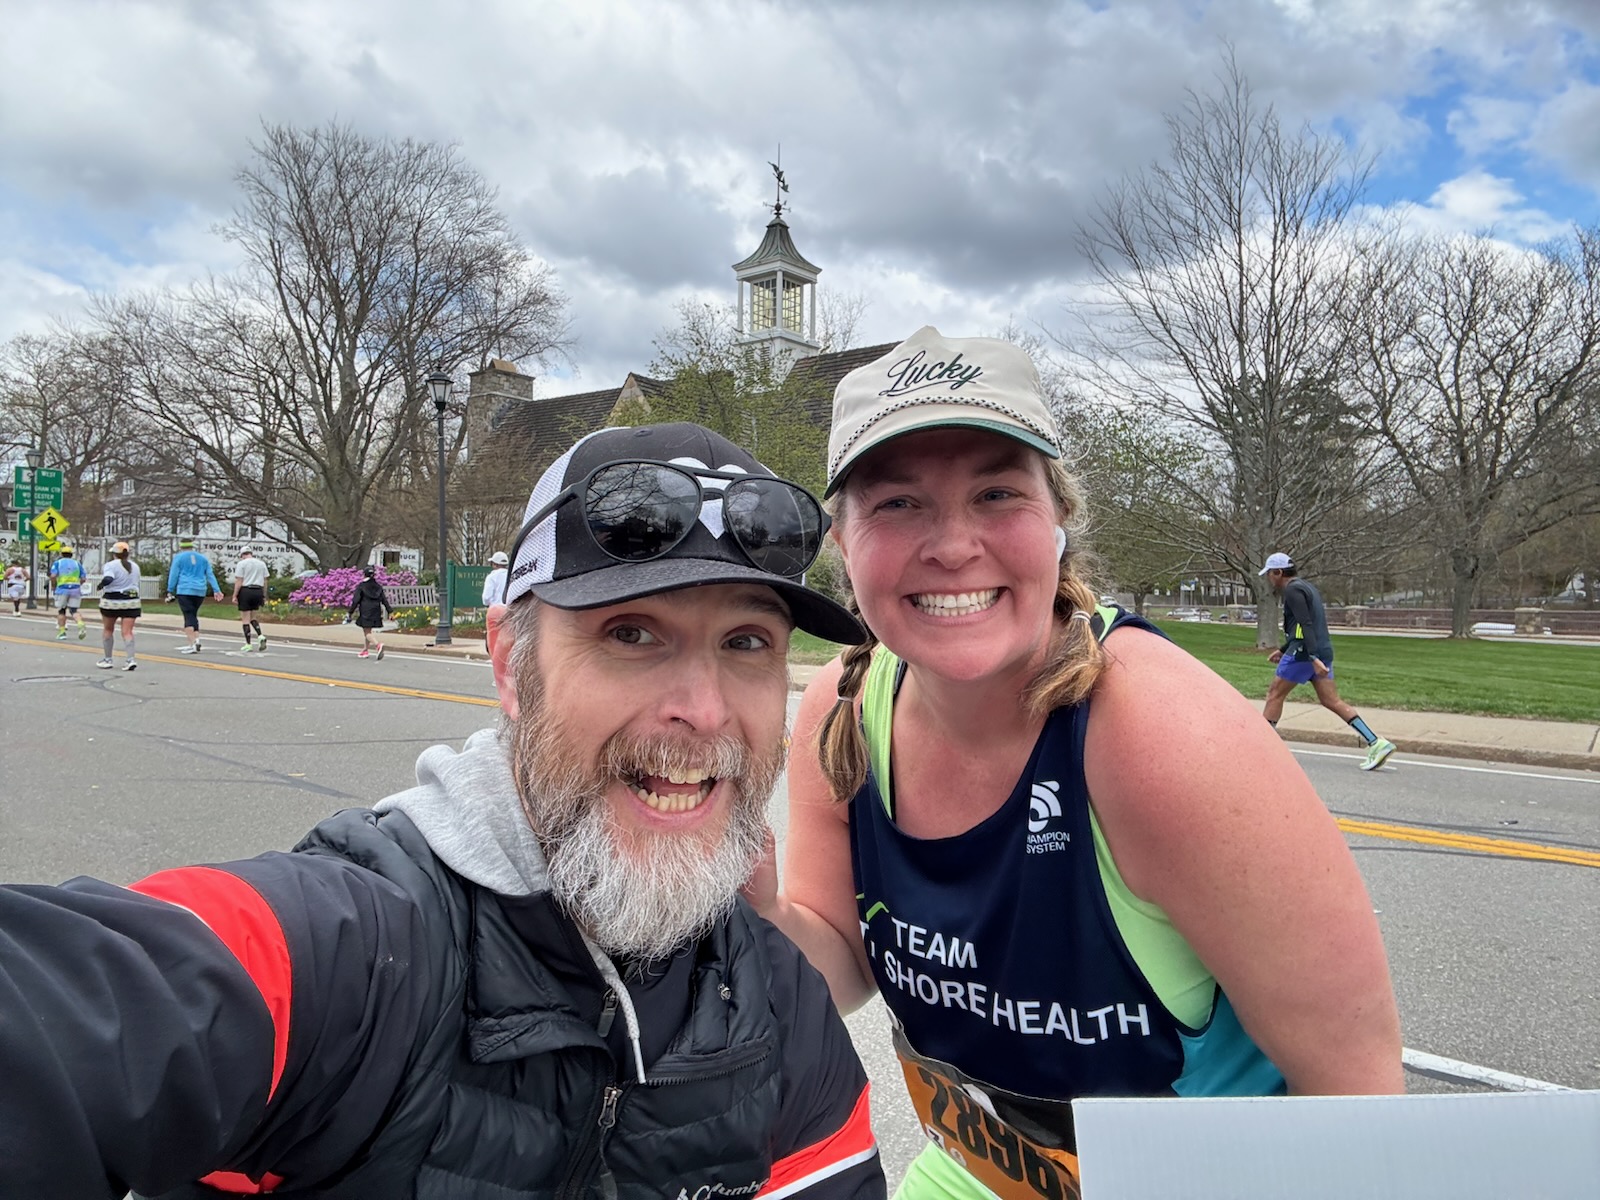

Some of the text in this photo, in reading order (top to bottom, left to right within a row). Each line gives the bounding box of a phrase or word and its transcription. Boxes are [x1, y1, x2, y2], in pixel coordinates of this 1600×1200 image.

[879, 350, 983, 396] Lucky
[16, 484, 49, 492] FRAMGHAM
[1026, 842, 1066, 855] SYSTEM
[1027, 831, 1071, 844] HAMPION
[891, 917, 978, 969] TEAM
[884, 950, 1150, 1046] SHORE HEALTH
